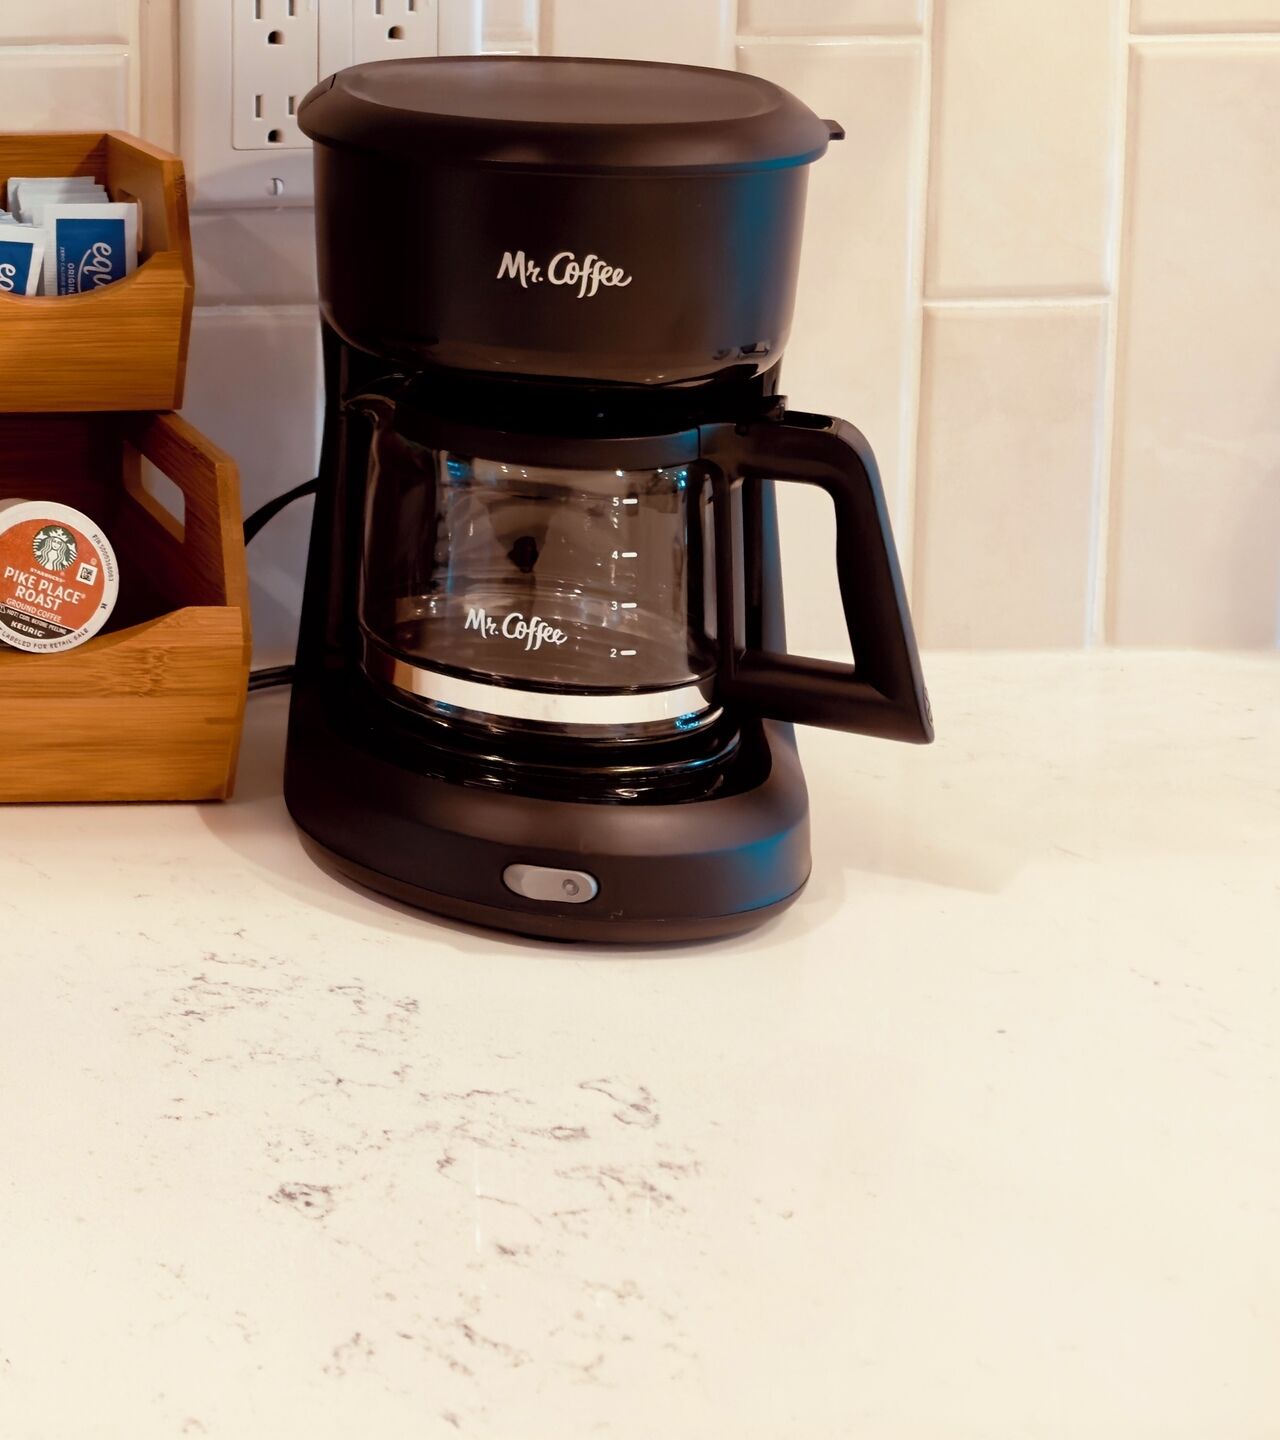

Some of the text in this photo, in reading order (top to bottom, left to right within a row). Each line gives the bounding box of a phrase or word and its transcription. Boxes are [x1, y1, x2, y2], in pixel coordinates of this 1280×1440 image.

[67, 263, 76, 293] ORIGIN
[496, 250, 633, 299] Mr. Coffee
[612, 498, 619, 507] 5
[611, 550, 619, 560] 4
[3, 566, 82, 605] PIKE PLACE
[14, 585, 63, 611] ROAST
[5, 597, 62, 624] GROUND COFFEE
[611, 601, 618, 610] 3
[10, 620, 46, 638] KEURIG
[464, 608, 568, 651] Mr. Coffee
[610, 648, 617, 658] 2
